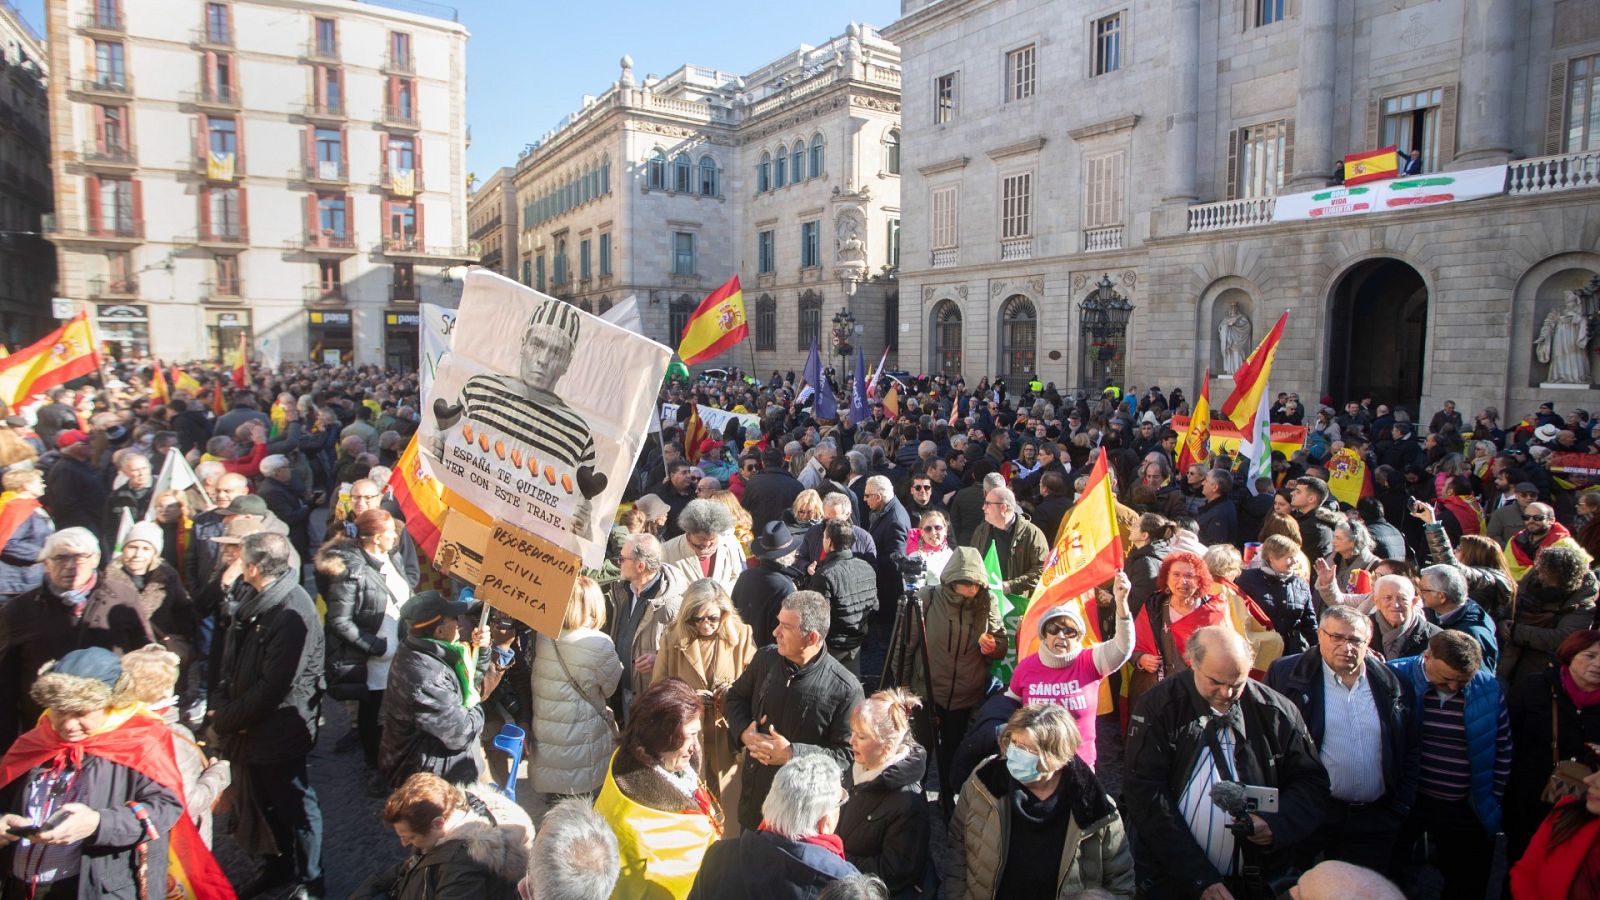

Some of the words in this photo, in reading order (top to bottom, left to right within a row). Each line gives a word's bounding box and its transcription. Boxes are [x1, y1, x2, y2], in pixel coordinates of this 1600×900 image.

[1331, 198, 1347, 206] VIDA
[323, 312, 349, 323] pans
[452, 446, 491, 474] ESPAÑA
[497, 467, 512, 485] TE
[516, 479, 560, 508] QUIERE
[445, 459, 465, 478] VER
[470, 471, 489, 491] CON
[494, 485, 520, 508] ESTE
[527, 502, 566, 531] TRAJE.
[504, 560, 542, 586] CIVIL
